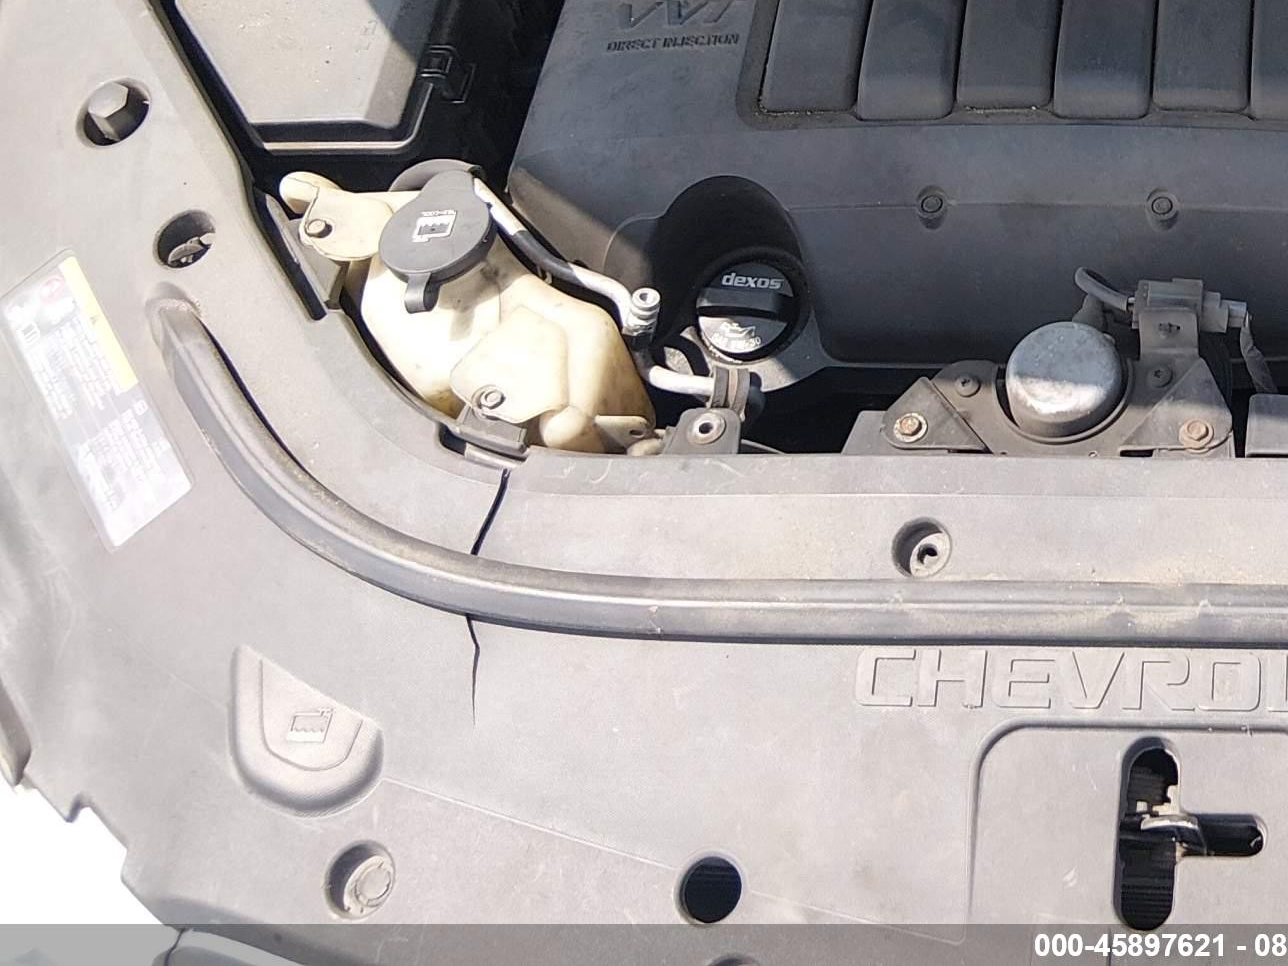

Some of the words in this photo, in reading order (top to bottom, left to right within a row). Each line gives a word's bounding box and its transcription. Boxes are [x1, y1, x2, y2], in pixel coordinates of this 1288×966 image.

[606, 37, 662, 52] DIRECT
[663, 33, 740, 48] INJECTION
[721, 272, 784, 290] dexos
